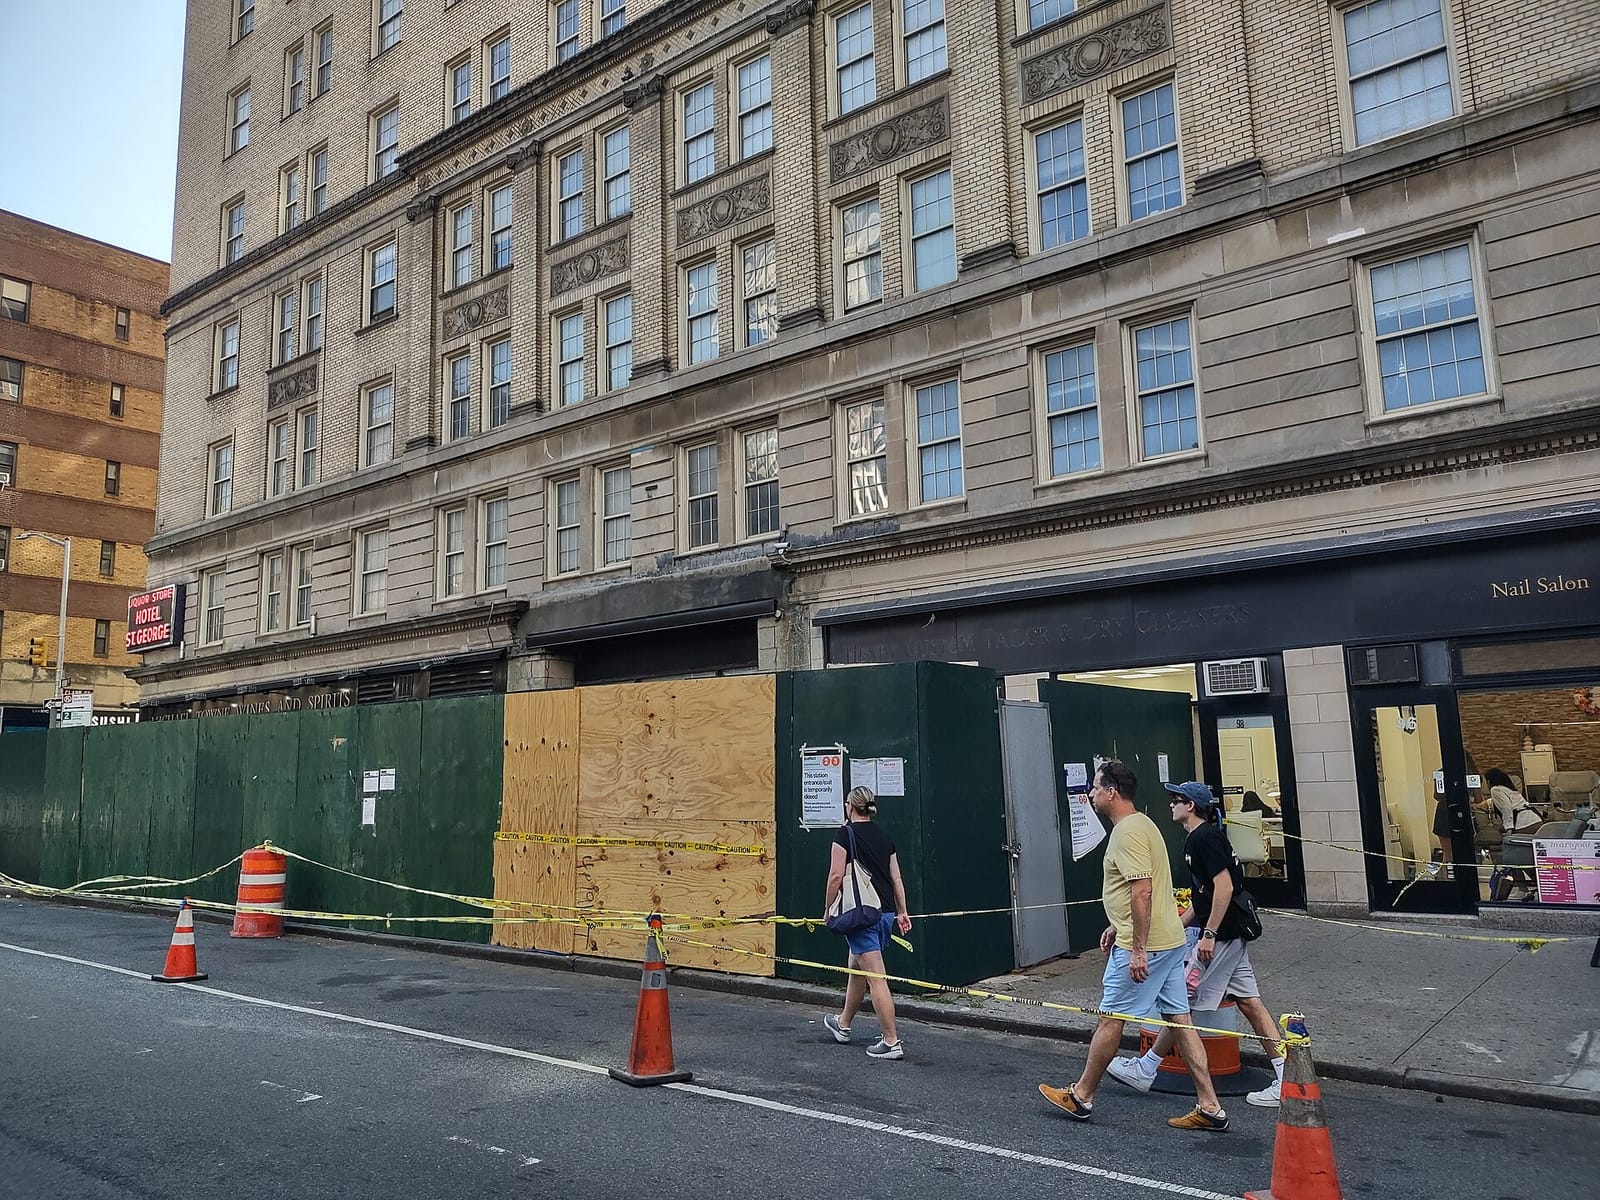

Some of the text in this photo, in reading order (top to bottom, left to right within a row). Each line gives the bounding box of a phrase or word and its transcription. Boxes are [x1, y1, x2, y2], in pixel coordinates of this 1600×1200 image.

[152, 588, 173, 602] STORE
[1491, 574, 1590, 598] Nail Salon
[135, 605, 161, 625] HOTEL
[236, 700, 271, 715] WINES
[278, 697, 302, 713] AND
[307, 689, 351, 710] SPIRITS
[501, 833, 520, 841] CAUTION
[525, 834, 544, 843] CAUTION
[550, 836, 570, 845] CAUTION
[576, 838, 598, 846] CAUTION
[664, 841, 687, 849] CAUTION
[694, 843, 718, 852] CAUTION
[725, 846, 751, 854] CAUTION
[1550, 841, 1592, 851] marigold
